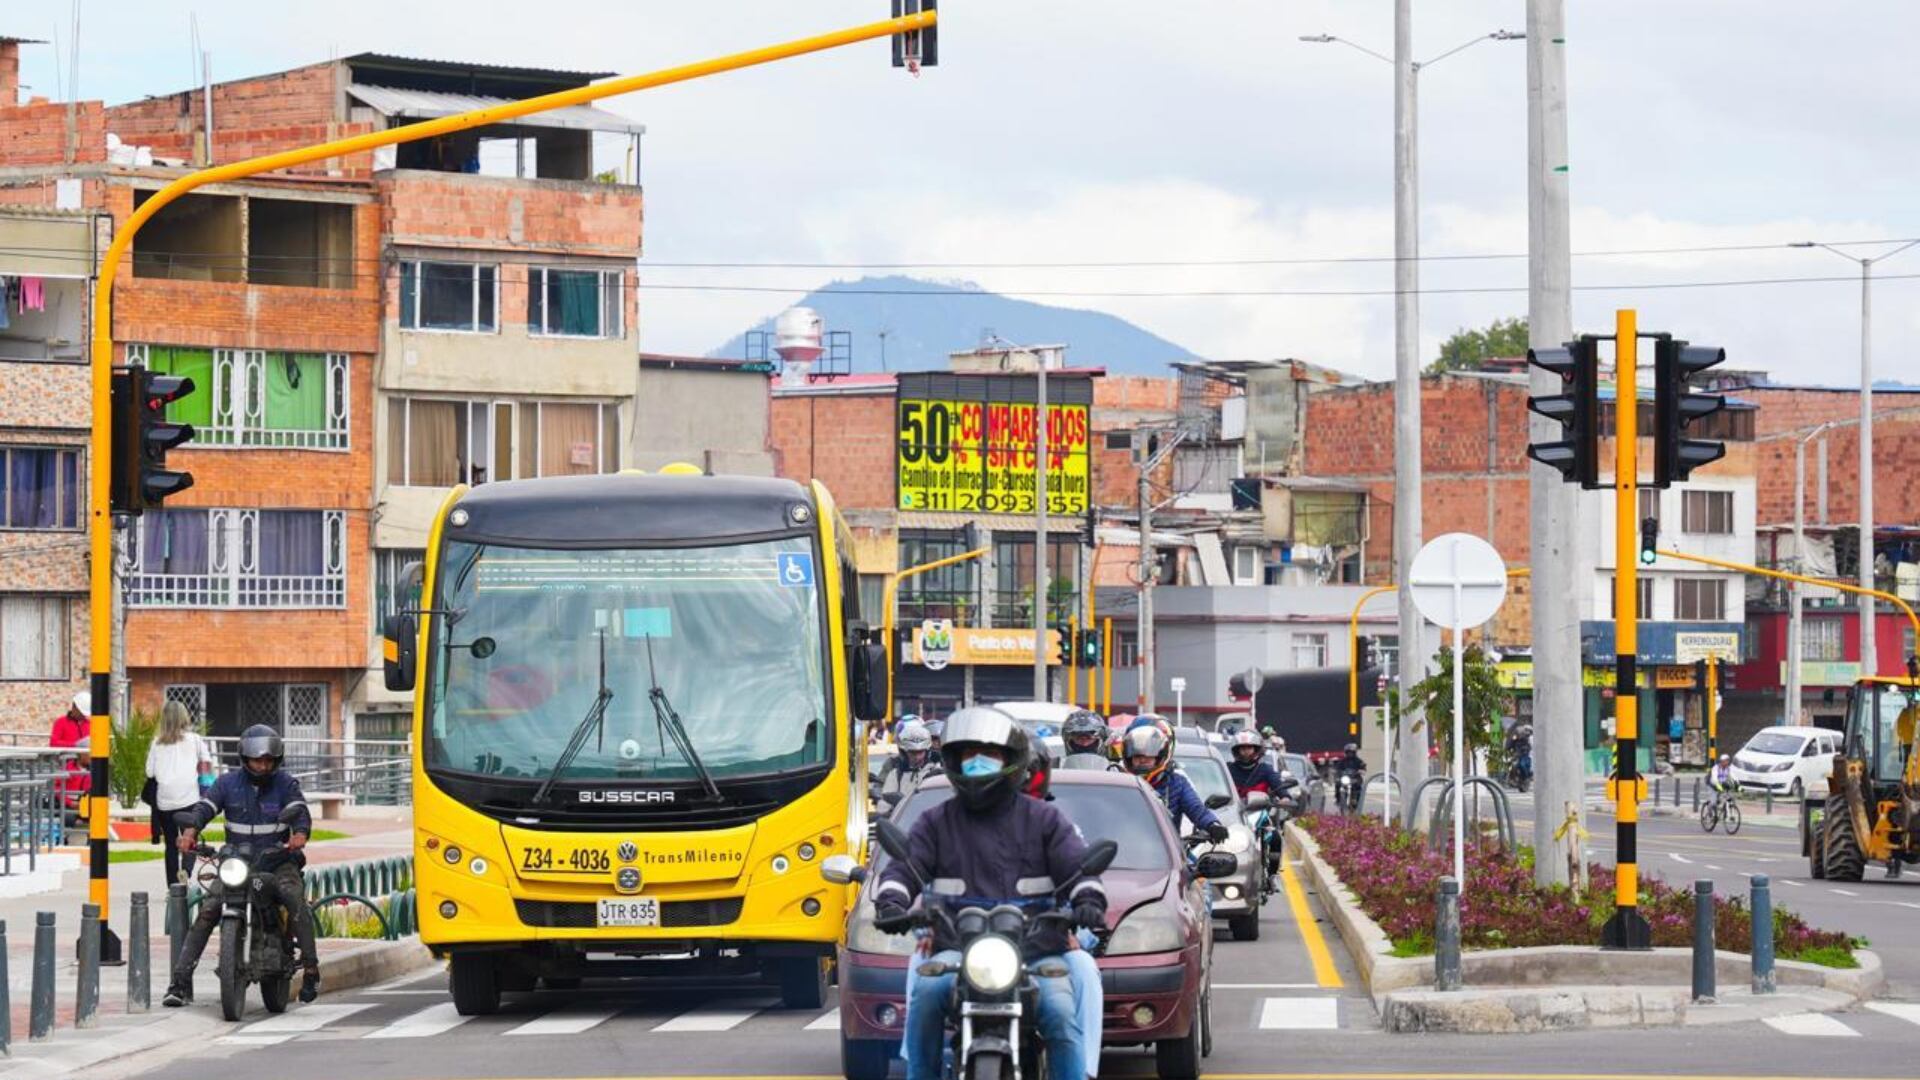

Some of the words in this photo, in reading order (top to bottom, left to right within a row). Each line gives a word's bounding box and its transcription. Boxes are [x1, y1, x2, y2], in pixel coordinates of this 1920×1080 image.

[901, 403, 949, 463] 50
[939, 467, 951, 488] de
[913, 491, 947, 510] 311
[578, 790, 676, 803] BUSSCAR
[523, 847, 553, 870] Z34
[569, 848, 610, 871] 4036
[644, 850, 743, 864] TransMilenio
[601, 904, 629, 919] JTR
[630, 904, 656, 919] 835
